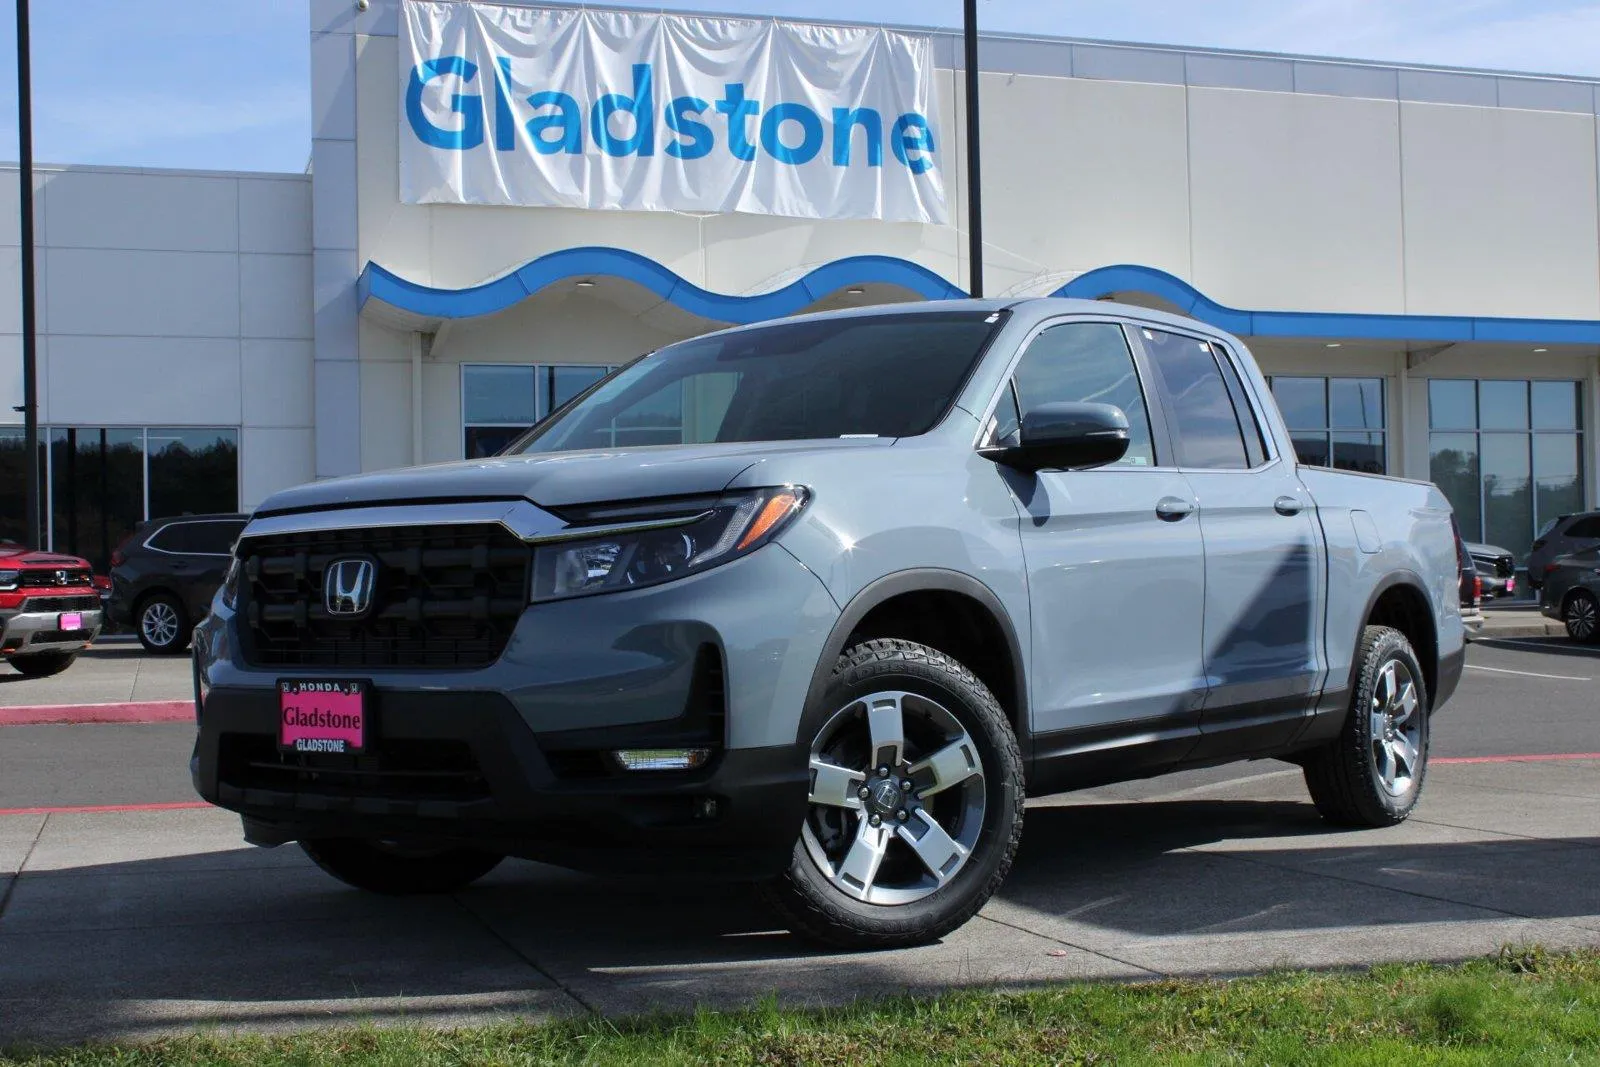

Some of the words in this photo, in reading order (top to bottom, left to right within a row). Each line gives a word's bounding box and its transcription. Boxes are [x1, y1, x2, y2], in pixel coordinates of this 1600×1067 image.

[405, 55, 936, 176] Gladstone
[299, 682, 341, 692] HONDA
[283, 706, 360, 729] Gladstone
[296, 738, 345, 753] GLADSTONE
